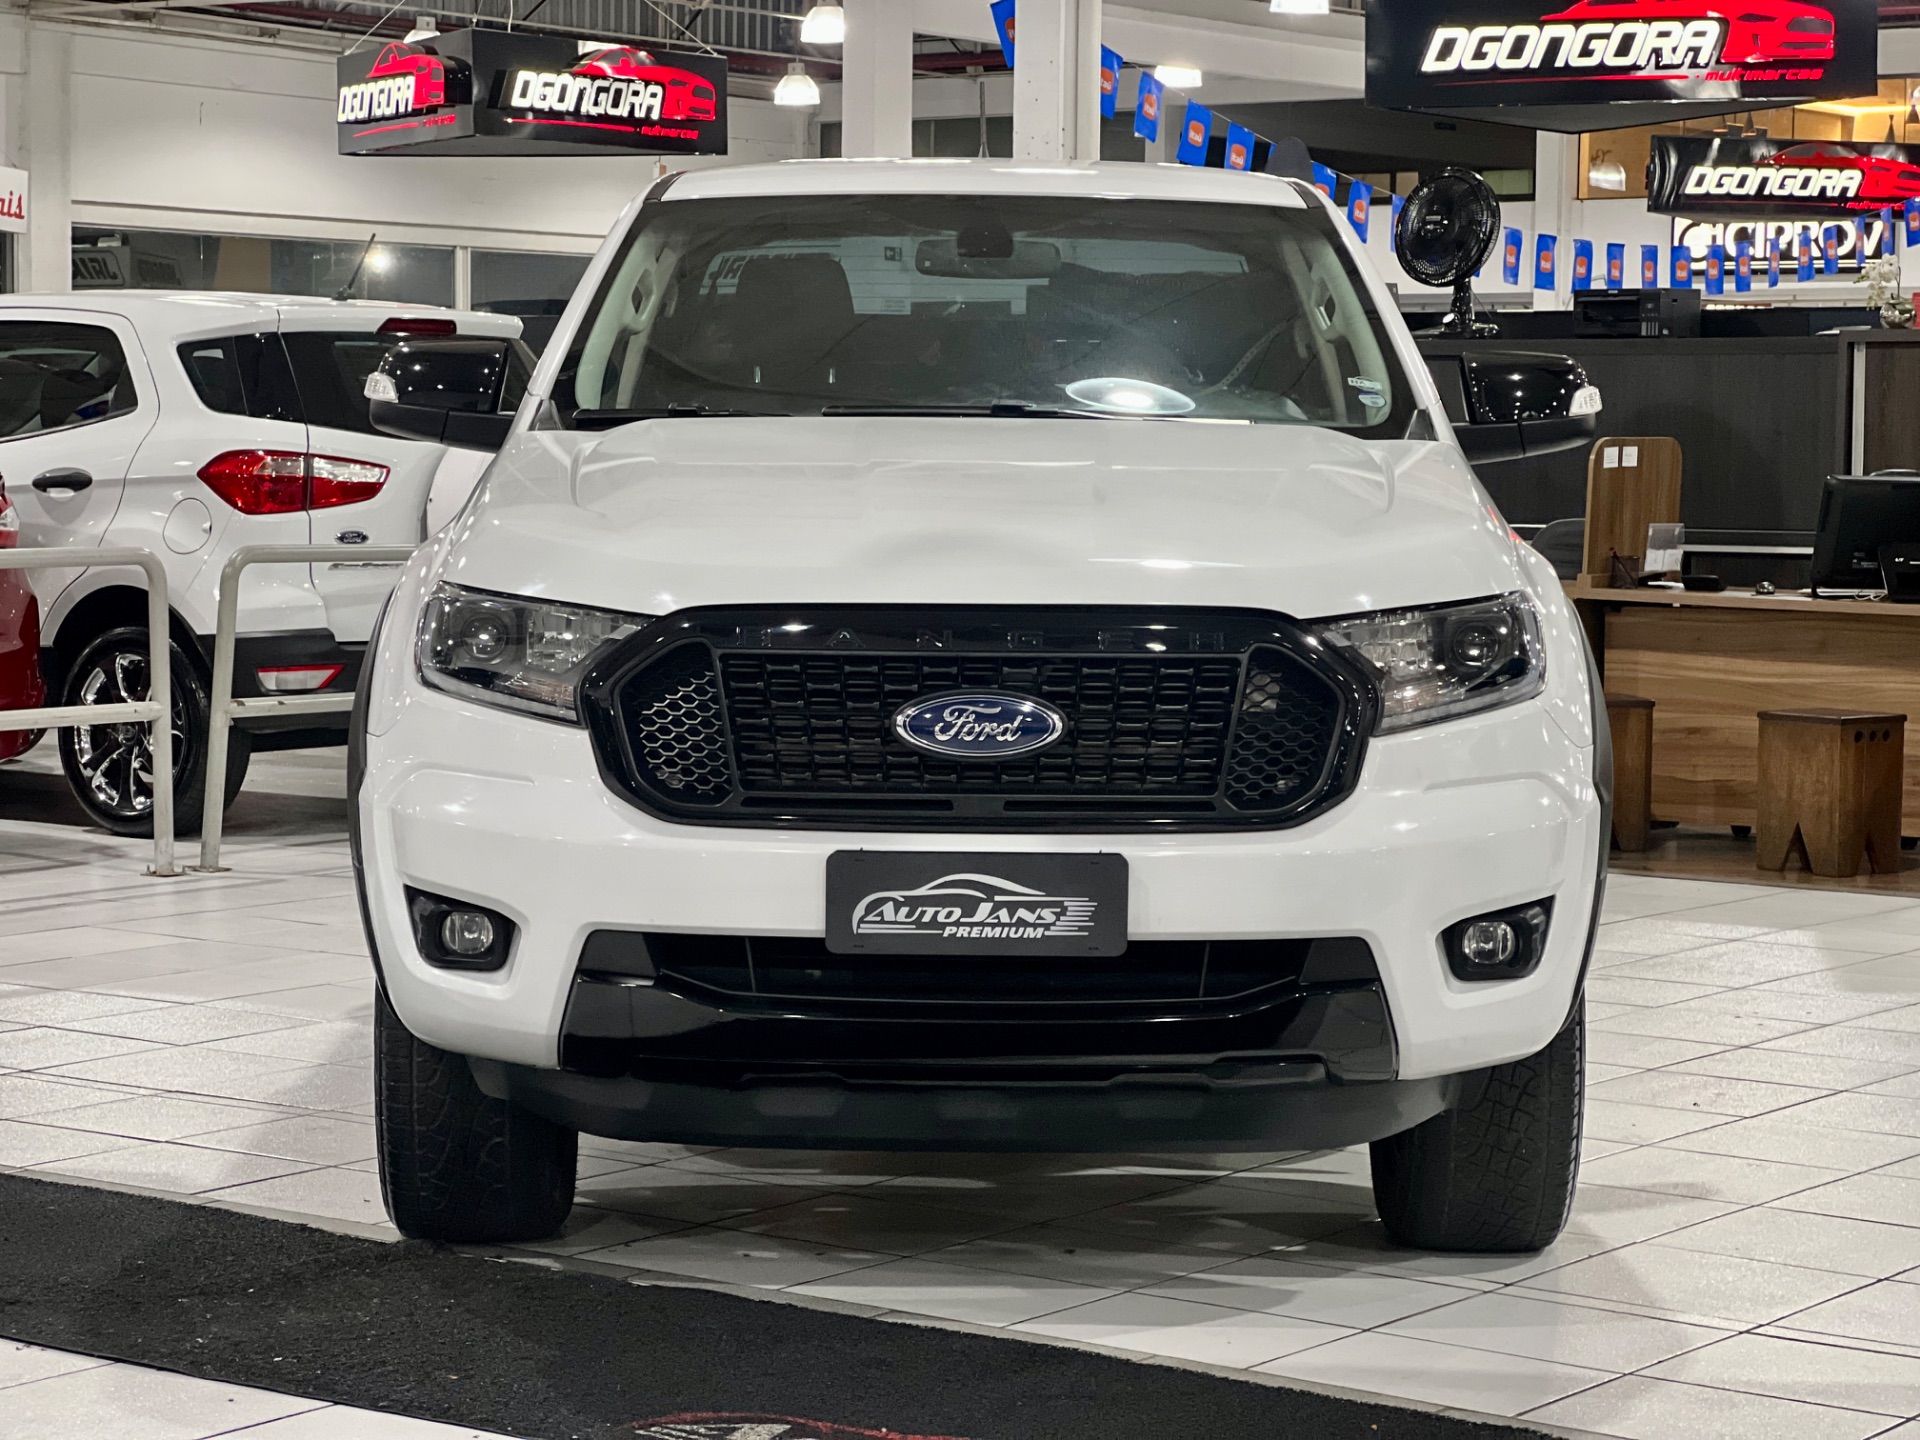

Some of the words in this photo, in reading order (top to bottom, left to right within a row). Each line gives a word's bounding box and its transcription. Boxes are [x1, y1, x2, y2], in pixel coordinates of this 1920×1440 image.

[1704, 67, 1824, 81] multimarcas
[1684, 165, 1863, 198] DGONGORA
[934, 705, 1024, 741] Ford
[942, 926, 1045, 939] PREMIUM
